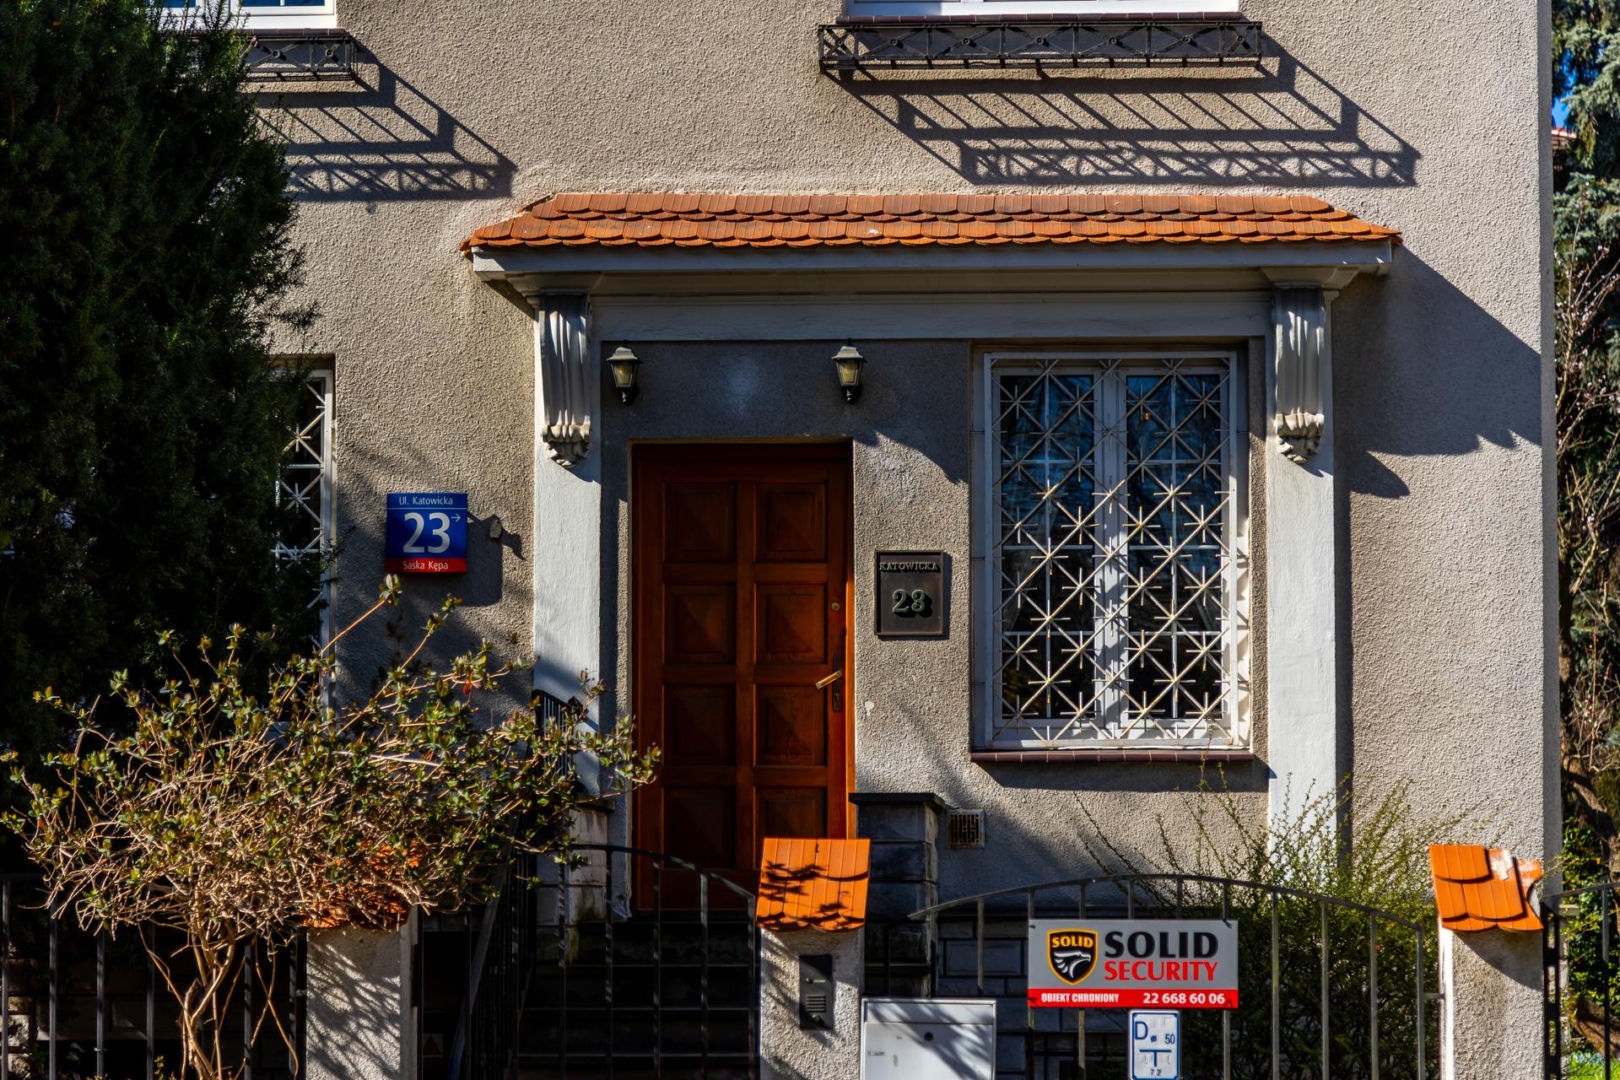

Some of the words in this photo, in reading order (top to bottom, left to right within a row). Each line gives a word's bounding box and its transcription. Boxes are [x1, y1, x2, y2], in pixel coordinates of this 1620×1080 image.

[399, 496, 409, 505] Ul.
[412, 496, 453, 505] Katowicka
[403, 512, 450, 553] 23
[403, 561, 425, 570] Saska
[428, 561, 449, 572] Kępa
[879, 561, 938, 570] KATOWICKA
[892, 588, 925, 613] 23
[1052, 935, 1093, 948] SOLID
[1104, 931, 1219, 958] SOLID
[1103, 960, 1218, 981] SECURITY
[1041, 993, 1070, 1003] OBIEKT
[1072, 993, 1119, 1003] CHRONIONY
[1143, 992, 1159, 1004] 22
[1162, 992, 1186, 1004] 668
[1189, 992, 1206, 1004] 60
[1208, 992, 1225, 1004] 06
[1165, 1033, 1176, 1045] 50
